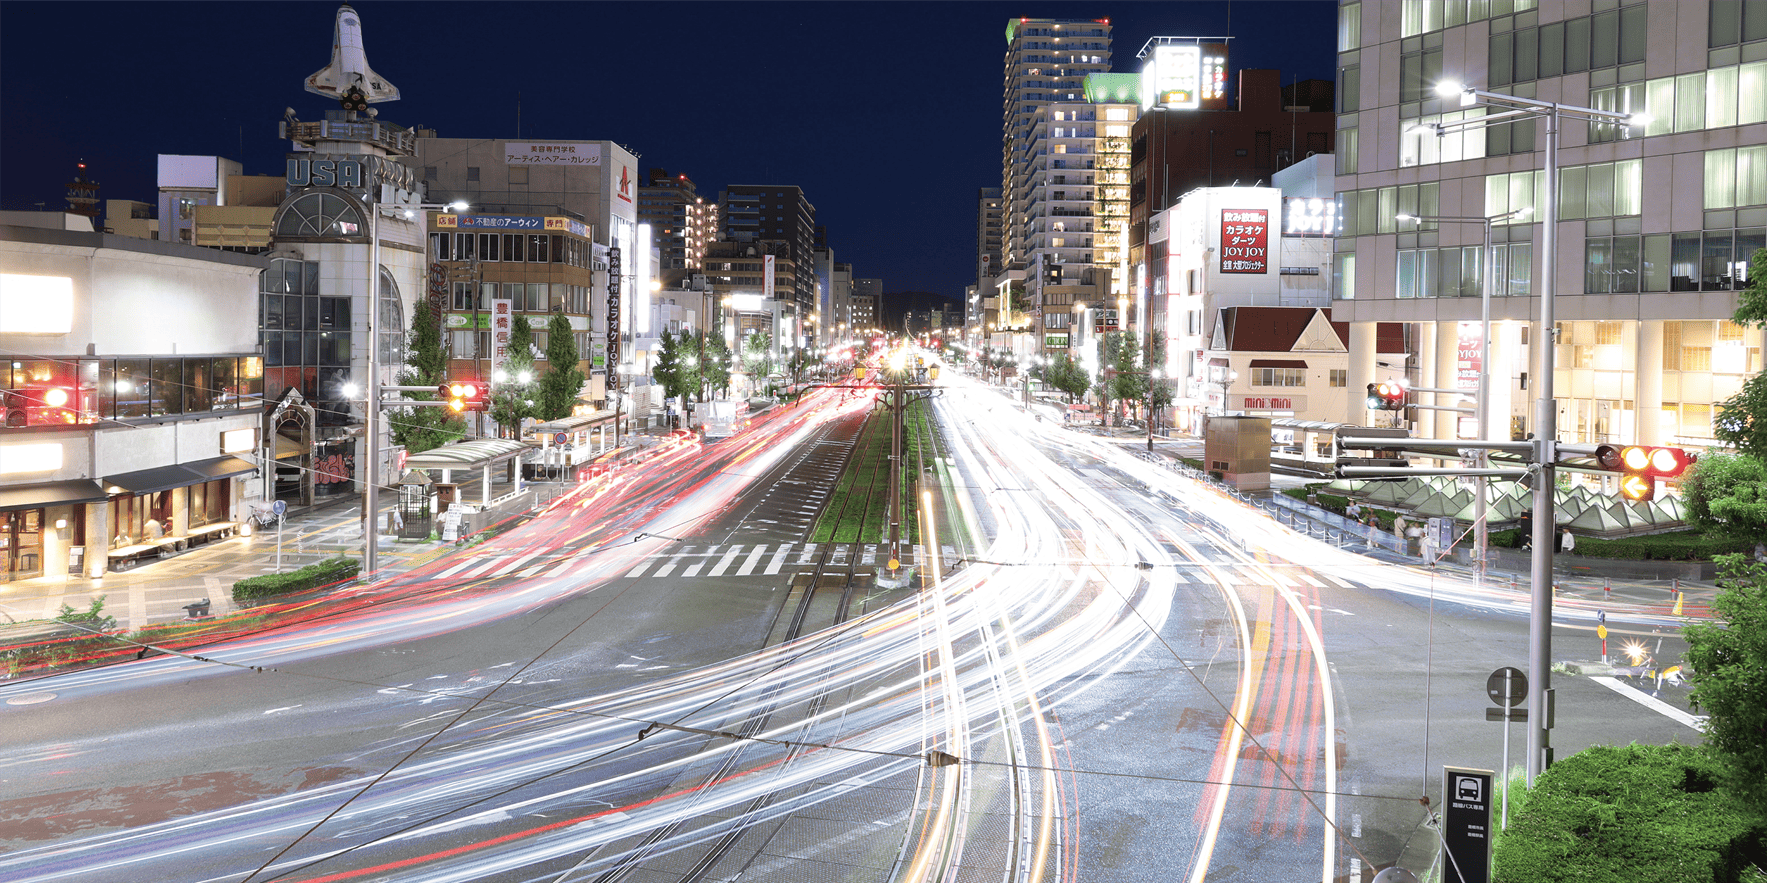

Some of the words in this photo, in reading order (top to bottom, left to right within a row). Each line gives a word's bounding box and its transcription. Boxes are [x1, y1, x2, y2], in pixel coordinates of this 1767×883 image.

[531, 145, 575, 153] 美容専門学校
[286, 159, 361, 187] USA
[438, 216, 456, 226] 店舗
[475, 217, 539, 227] 不動産のアーウィン
[546, 219, 563, 228] 専門
[1225, 225, 1264, 235] カラオケ
[1231, 236, 1256, 245] ダーツ
[1223, 247, 1244, 257] JOY
[1244, 247, 1265, 257] JOY
[610, 297, 619, 340] カラオケ
